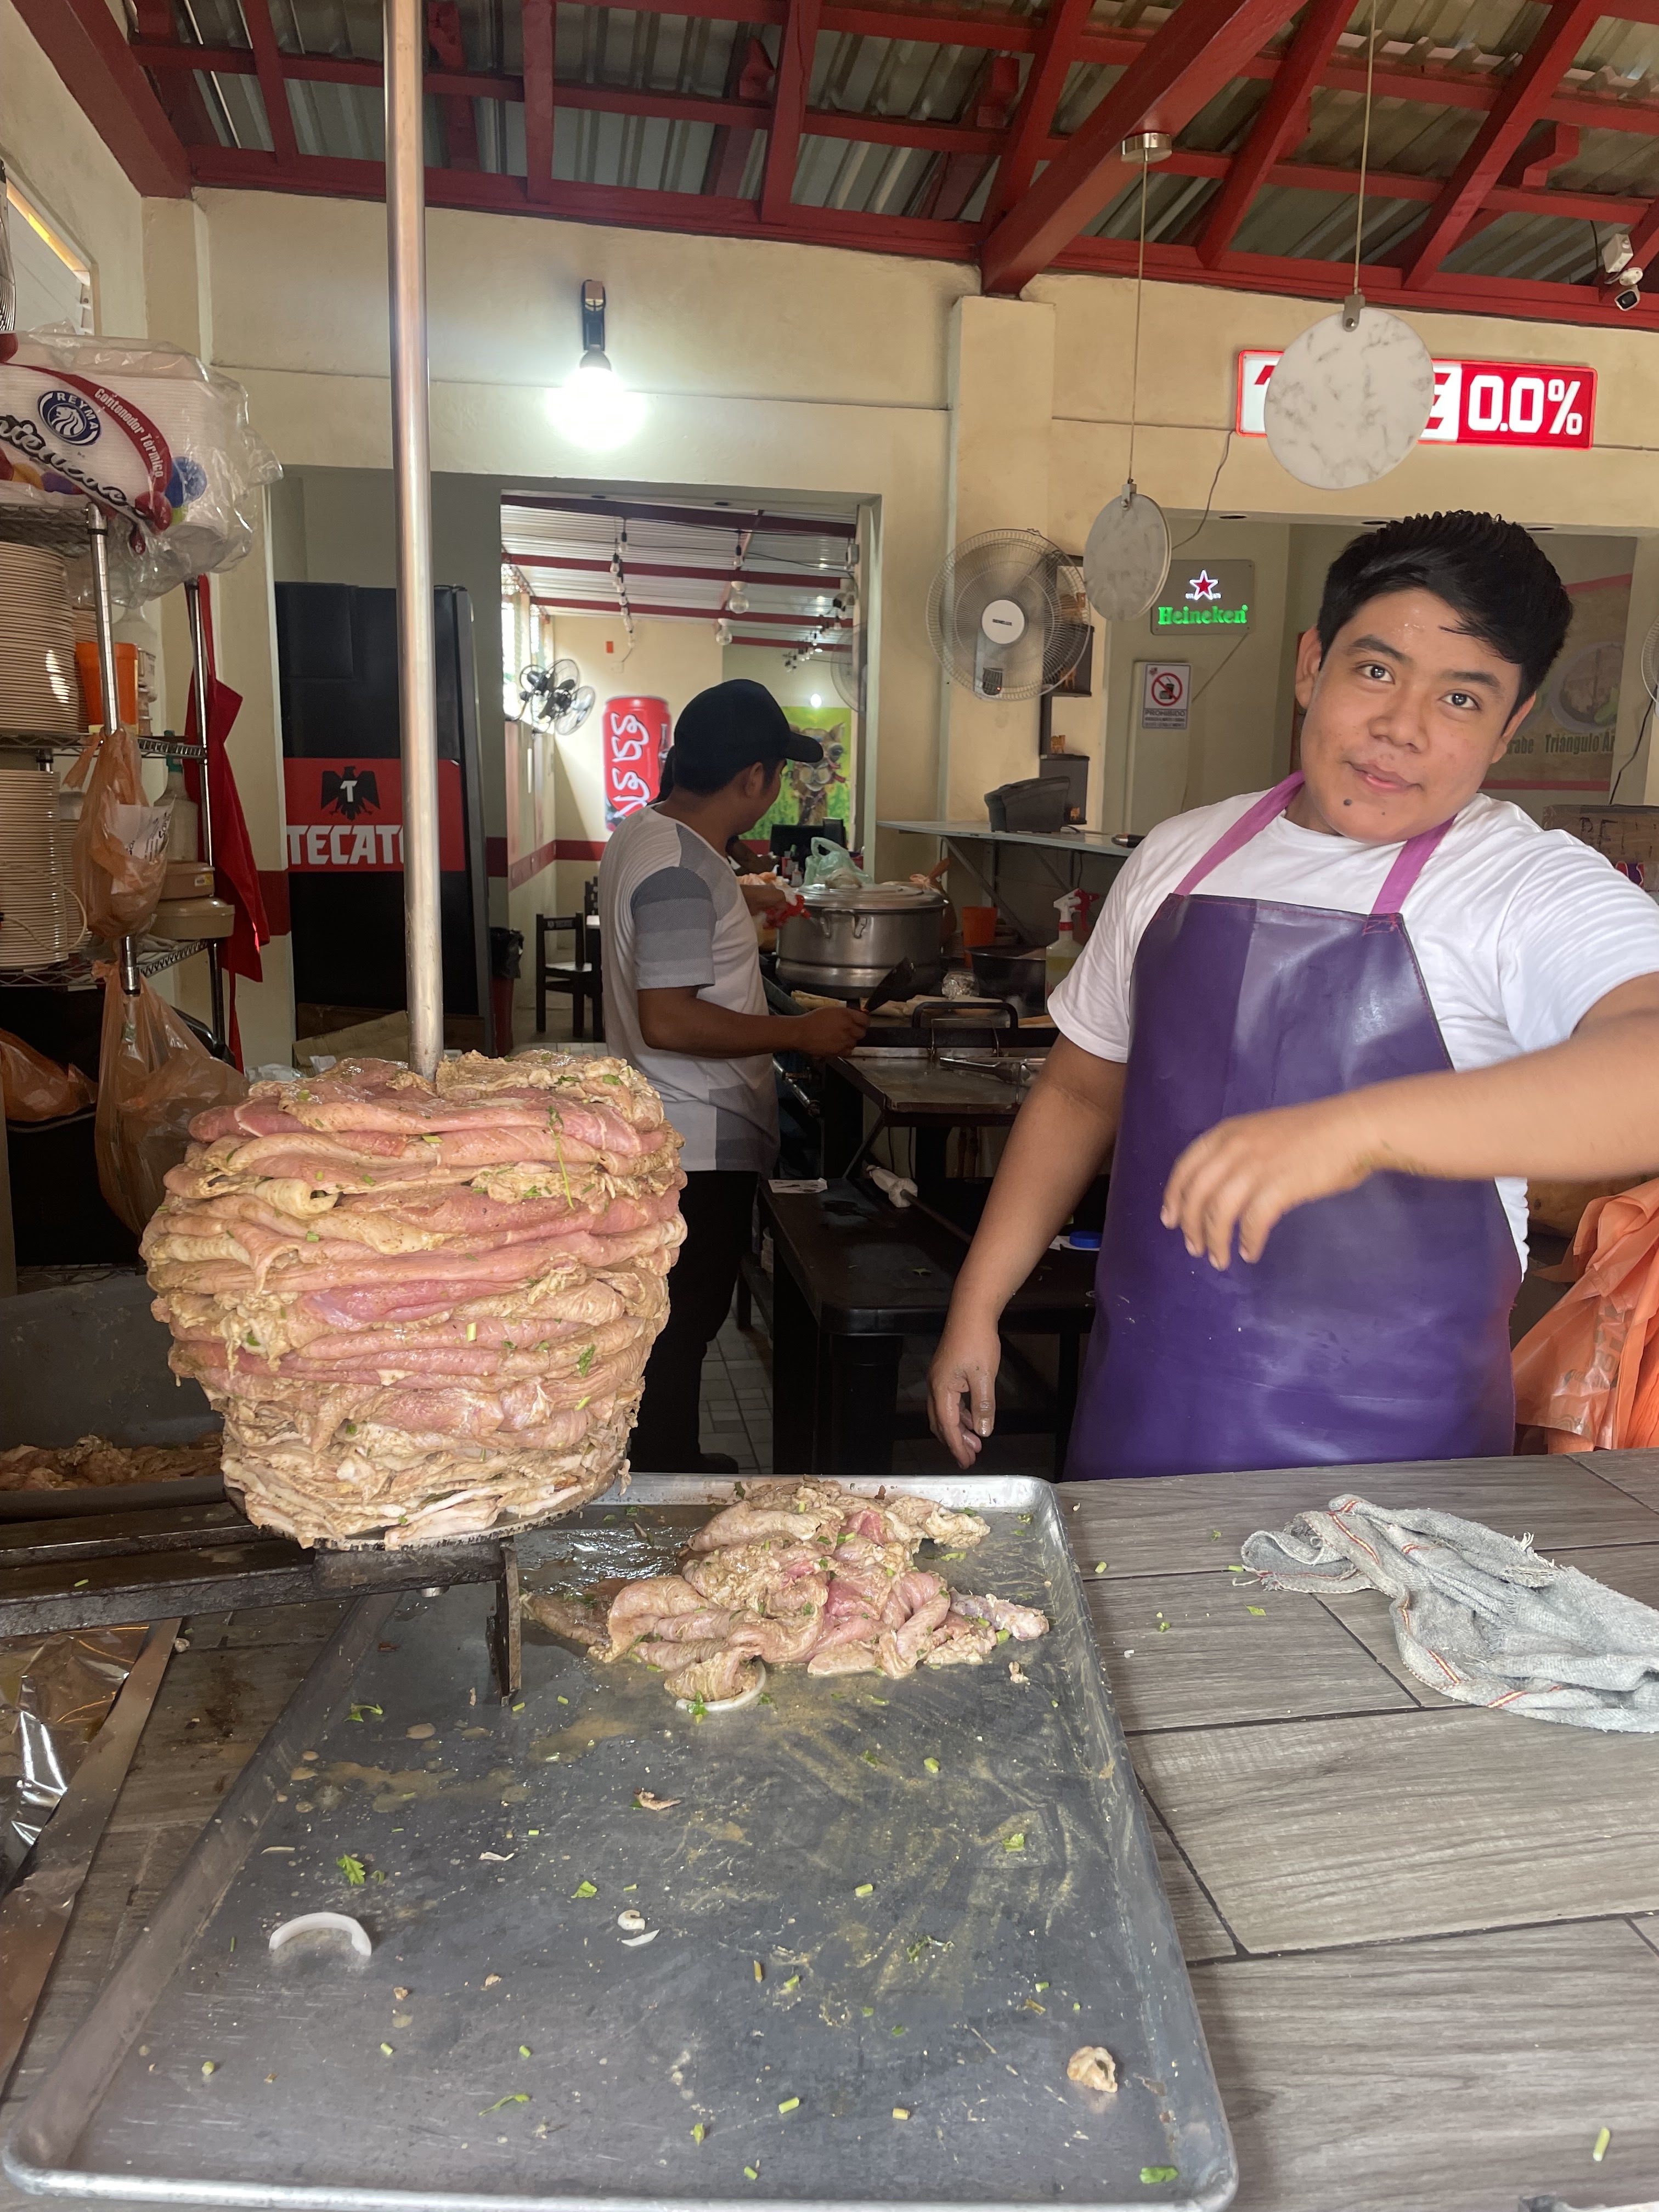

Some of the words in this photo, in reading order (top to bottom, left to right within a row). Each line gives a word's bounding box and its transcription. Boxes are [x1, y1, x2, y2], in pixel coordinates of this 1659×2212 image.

[57, 392, 99, 430] REYMA
[94, 388, 145, 434] Contenedor
[1468, 374, 1583, 435] 0.0%
[1158, 605, 1248, 625] Heineken
[286, 825, 404, 865] TECAT
